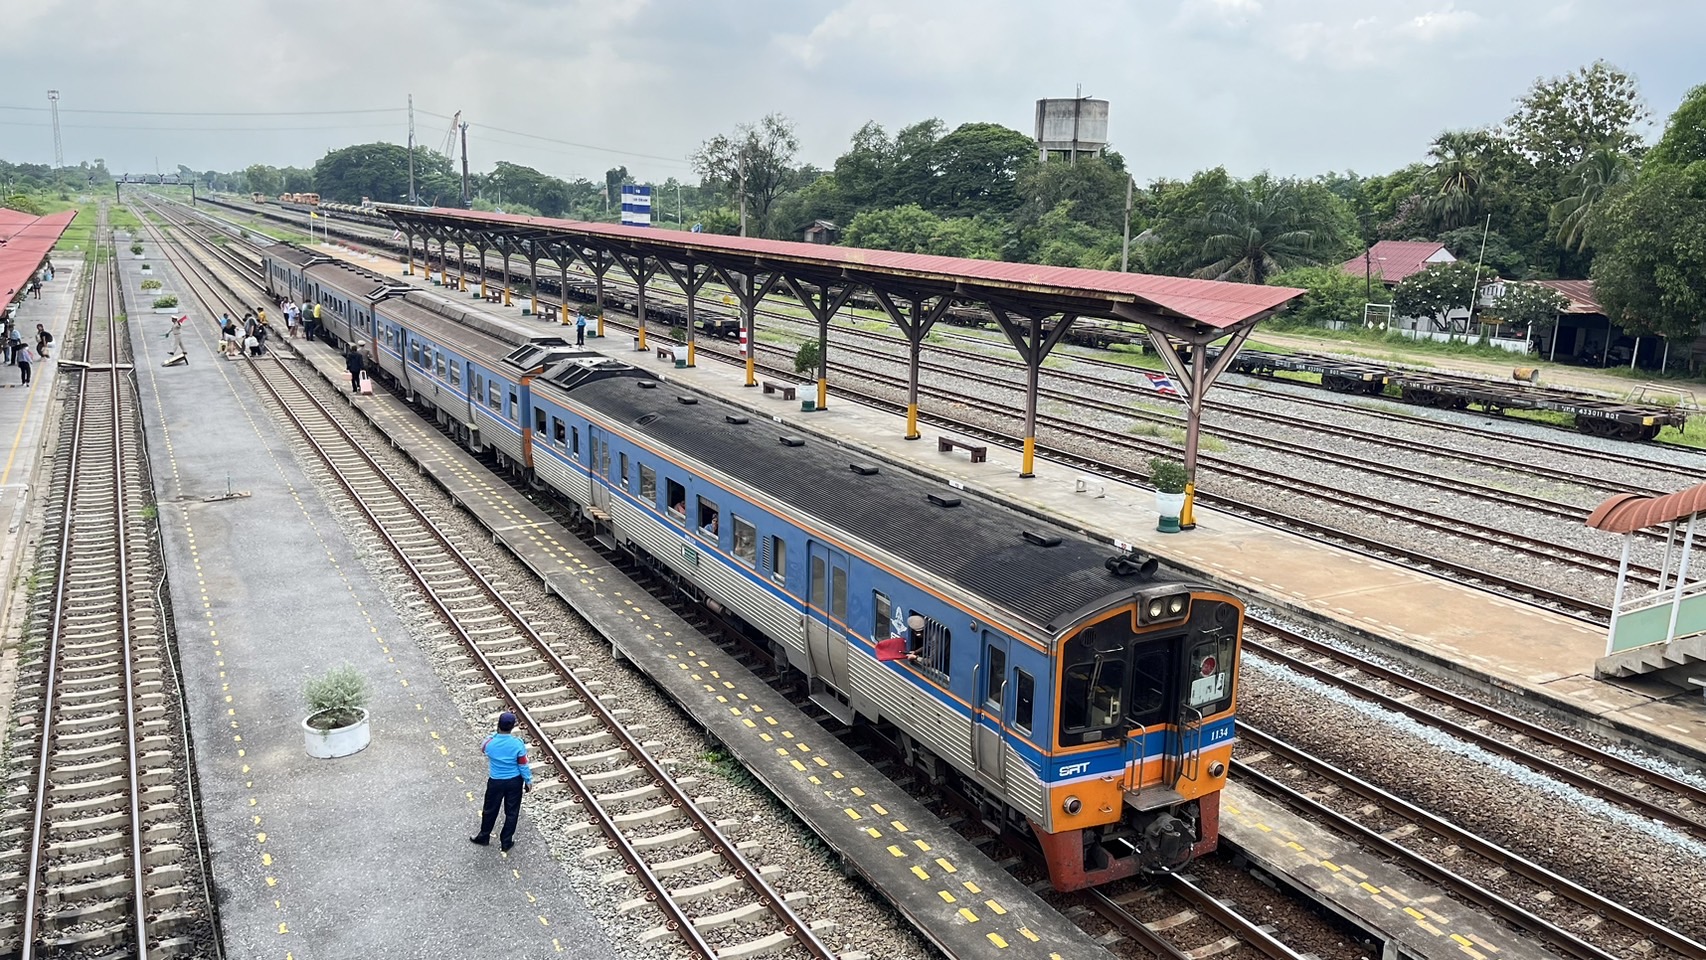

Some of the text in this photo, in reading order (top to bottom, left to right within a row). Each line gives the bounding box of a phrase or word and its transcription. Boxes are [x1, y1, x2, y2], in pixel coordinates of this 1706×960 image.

[1578, 408, 1603, 417] 433011
[1211, 727, 1229, 741] 1134
[1059, 761, 1090, 777] SRT
